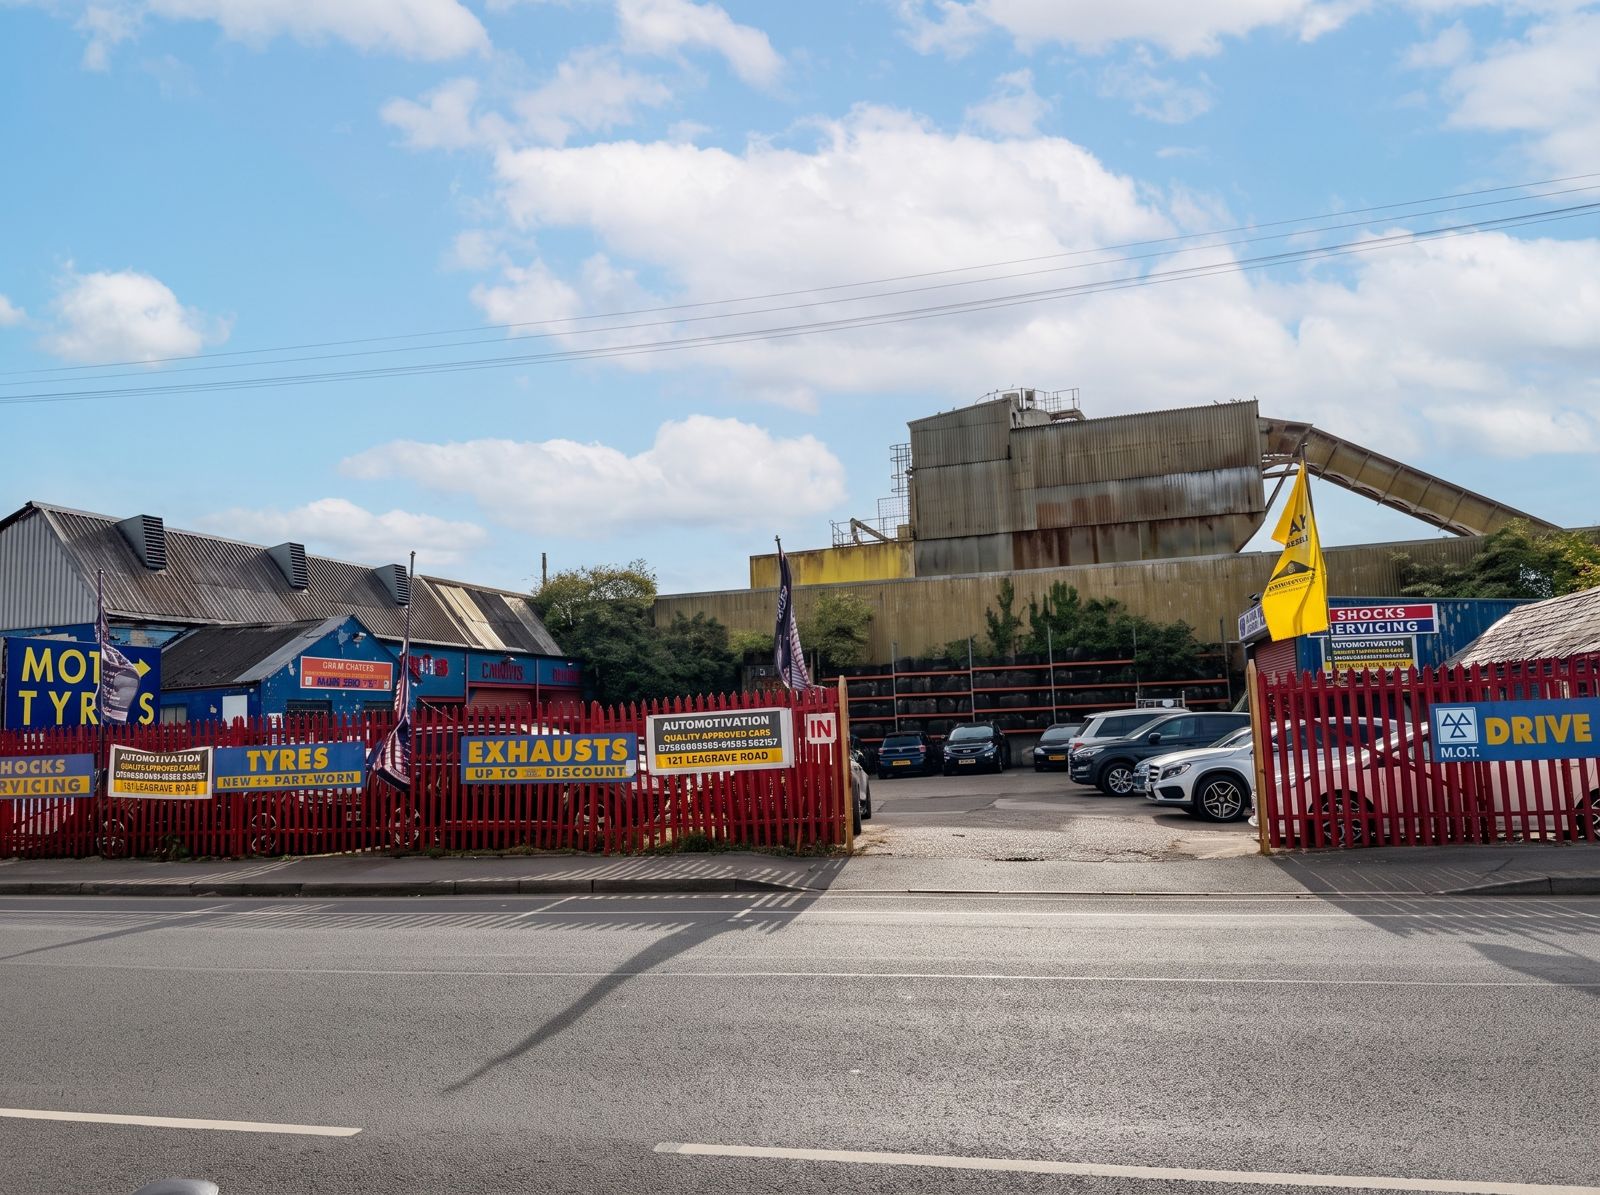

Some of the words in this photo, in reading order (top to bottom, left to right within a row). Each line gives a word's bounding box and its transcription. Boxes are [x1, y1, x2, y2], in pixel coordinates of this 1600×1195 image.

[1337, 607, 1406, 621] SHOCKS
[1330, 621, 1418, 635] ERVICING
[21, 646, 100, 684] MOT
[18, 690, 155, 726] TYRS
[662, 715, 770, 731] AUTOMOTIVATION
[810, 719, 832, 738] IN
[1484, 713, 1593, 746] DRIVE
[663, 732, 702, 743] QUALITY
[702, 730, 748, 741] APPROVED
[749, 729, 771, 738] CARS
[120, 753, 201, 763] AUTOMOTIVATION
[468, 738, 628, 764] EXHAUSTS
[667, 756, 683, 766] 121
[686, 753, 738, 764] LEAGRAVE
[740, 751, 769, 761] ROAD
[1440, 746, 1480, 759] M.O.T.
[246, 747, 329, 772] TYRES
[223, 777, 251, 787] NEW
[274, 773, 356, 785] PART-WORN
[475, 769, 494, 779] UP
[501, 768, 518, 778] TO
[546, 766, 625, 779] DISCOUNT
